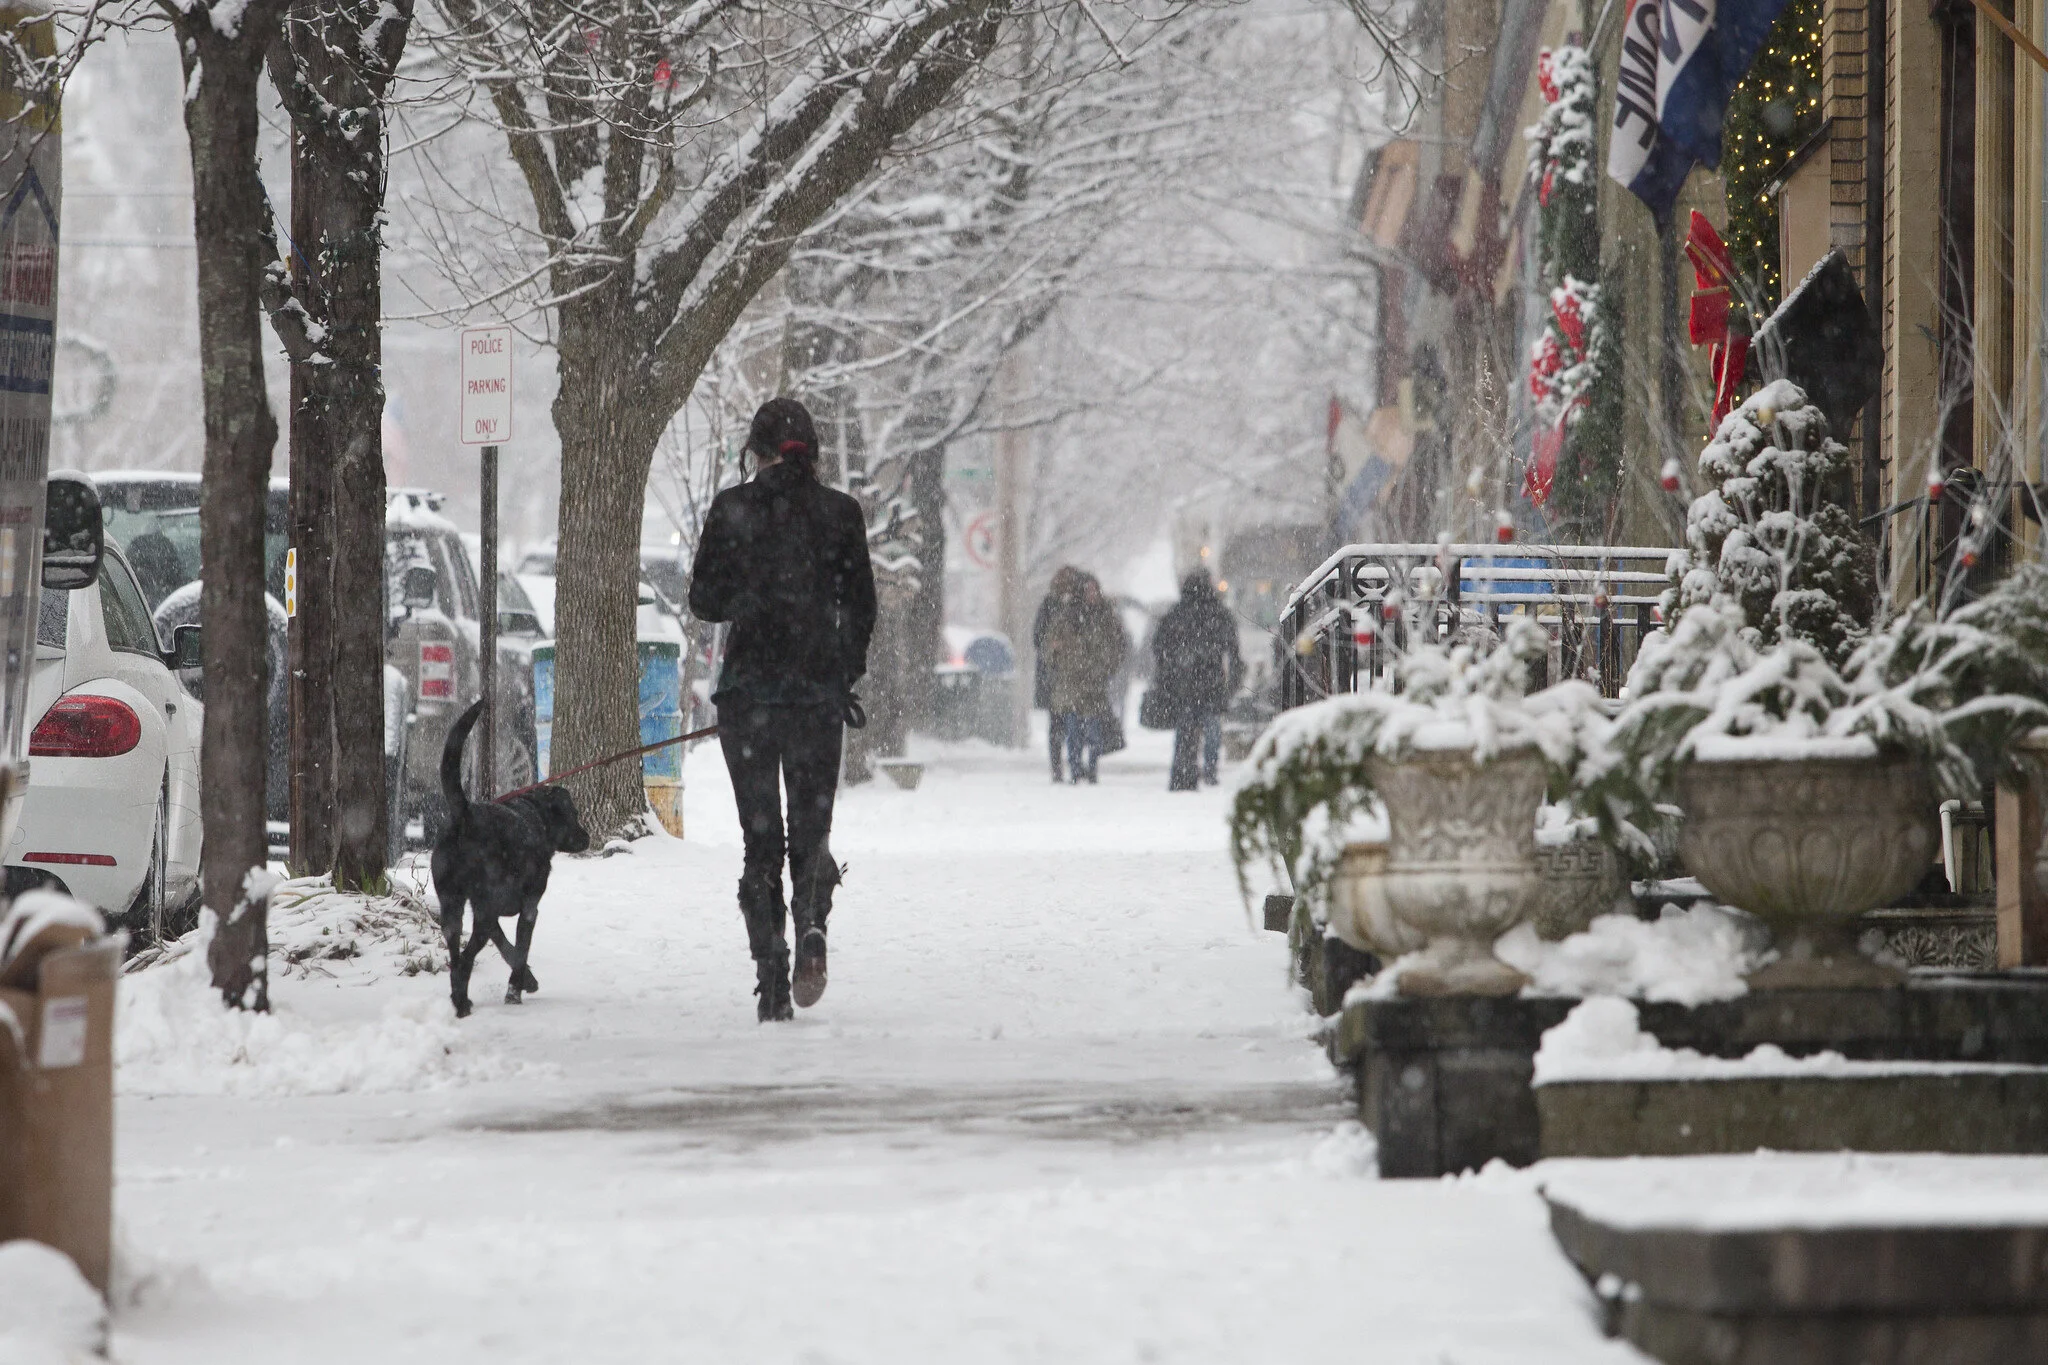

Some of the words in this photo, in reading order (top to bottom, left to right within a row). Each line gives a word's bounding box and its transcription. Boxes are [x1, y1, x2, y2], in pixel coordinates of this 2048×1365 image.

[471, 339, 503, 355] POLICE
[468, 379, 506, 395] PARKING
[475, 419, 498, 434] ONLY
